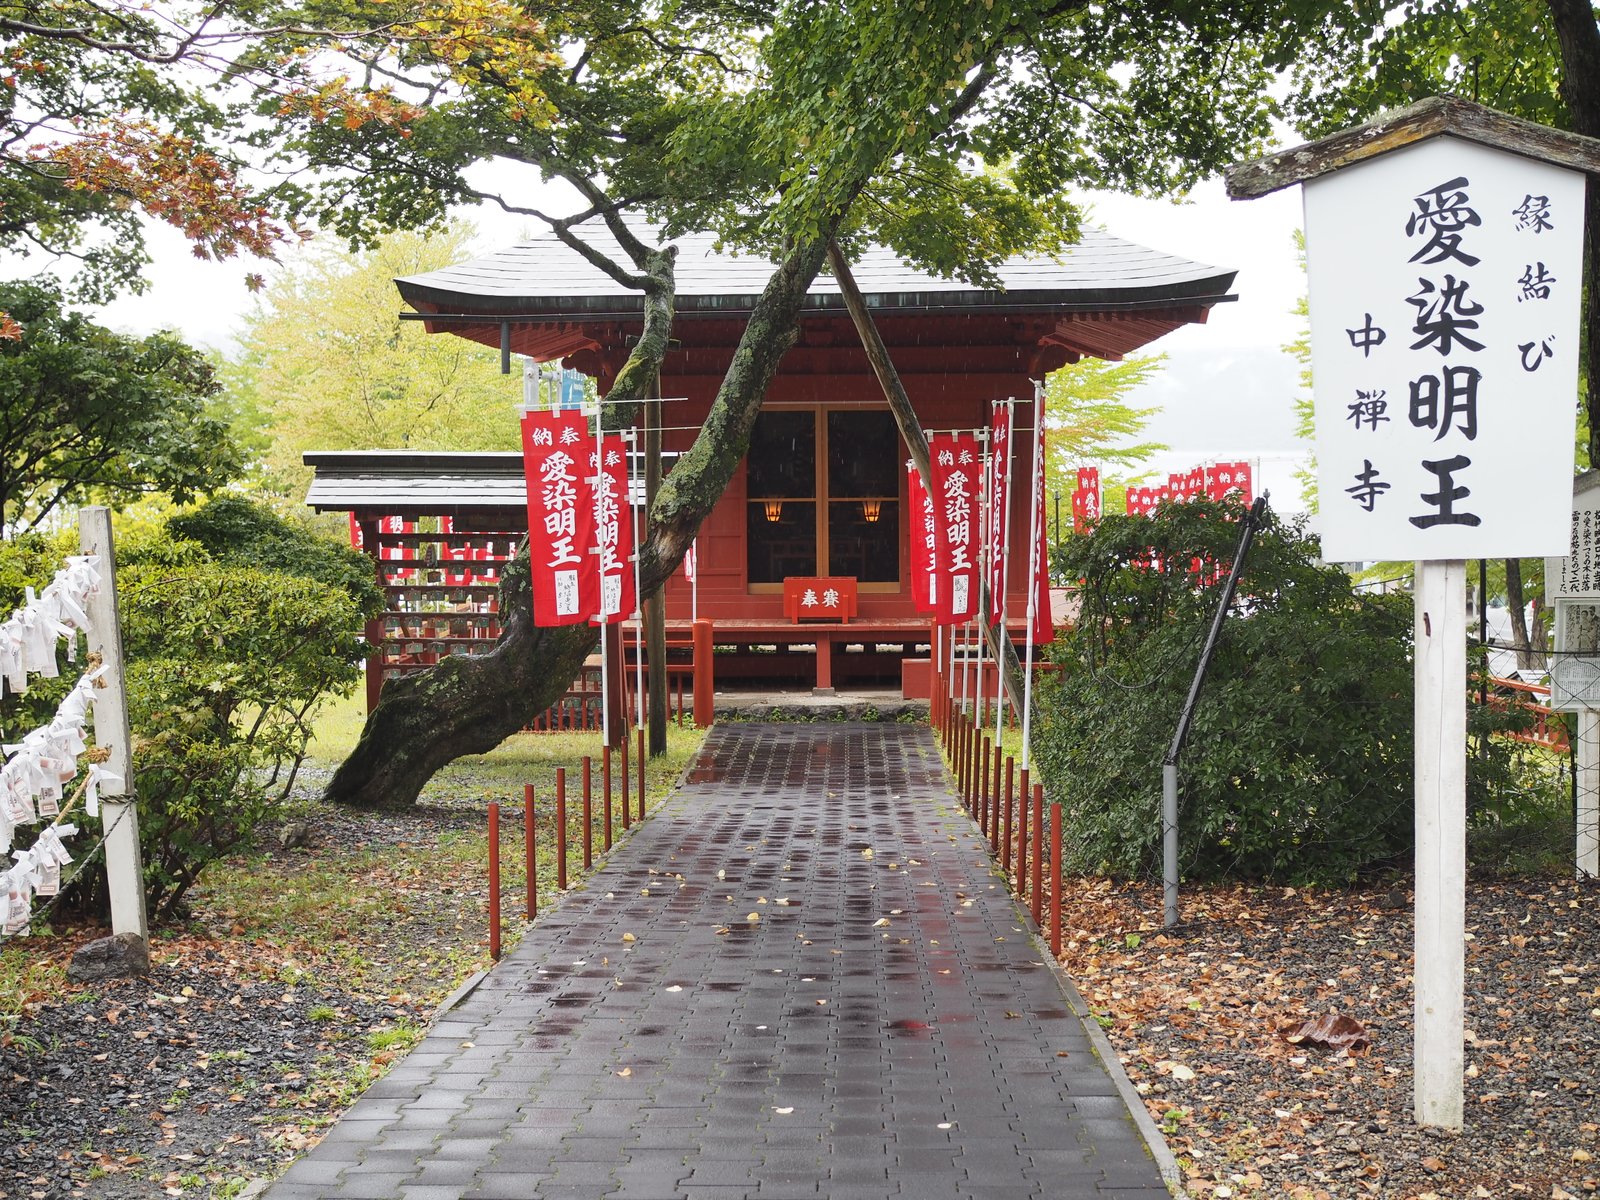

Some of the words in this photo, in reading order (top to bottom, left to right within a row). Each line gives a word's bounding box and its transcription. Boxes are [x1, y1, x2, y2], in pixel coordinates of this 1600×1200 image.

[1404, 176, 1487, 530] 愛染明王
[1511, 194, 1556, 372] 縁結び
[1344, 313, 1391, 512] 中禅寺
[539, 450, 581, 568] 愛染明王
[943, 470, 972, 573] 愛染明王
